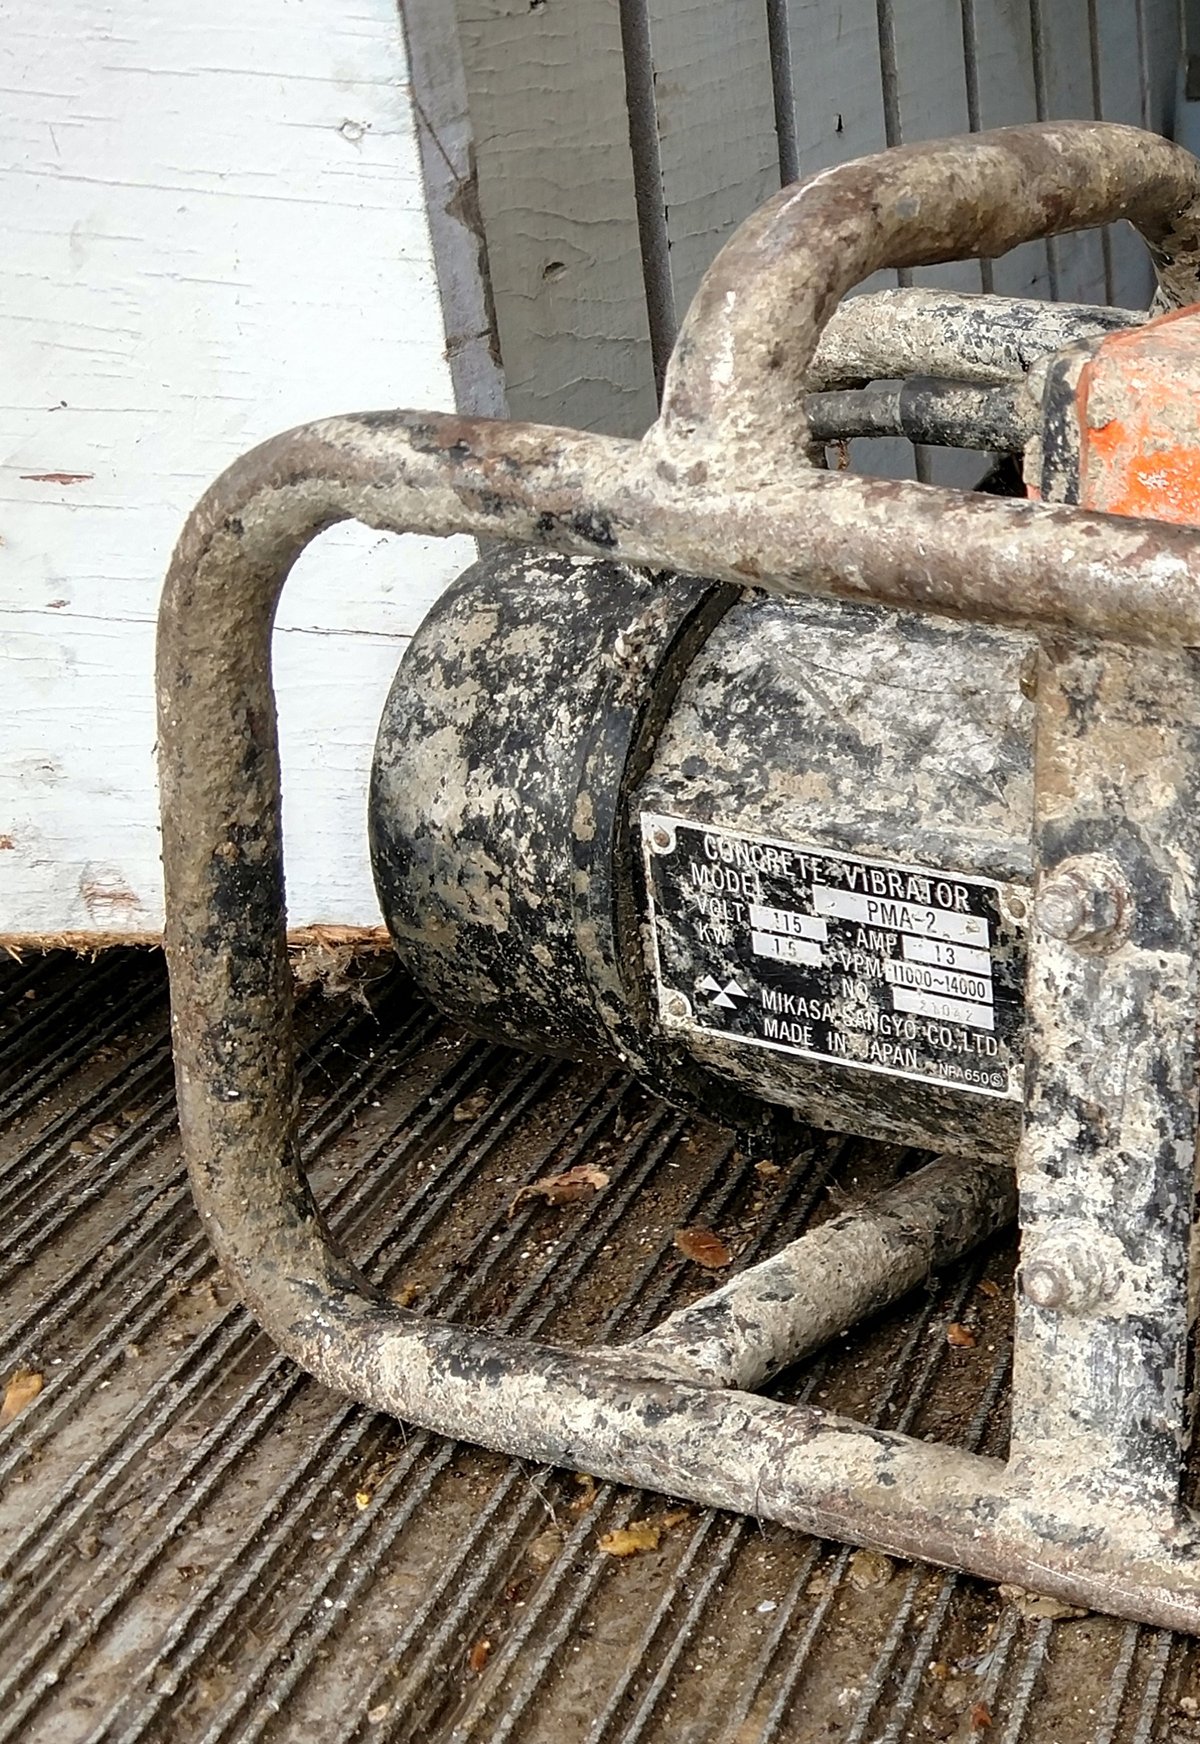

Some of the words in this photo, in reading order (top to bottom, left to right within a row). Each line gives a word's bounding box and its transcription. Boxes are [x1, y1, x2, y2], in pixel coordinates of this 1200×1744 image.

[690, 862, 768, 899] MODEL
[867, 900, 937, 933] PMA-2
[704, 834, 826, 883] CONCRETE
[843, 864, 971, 912] VIBRATOR
[696, 895, 744, 922] VOLT
[856, 929, 898, 954] AMP
[935, 945, 955, 965] 13
[839, 951, 882, 978] VPM
[762, 989, 834, 1023] MIKASA
[842, 1004, 917, 1040] SANGYO
[764, 1018, 814, 1046] MADE
[828, 1031, 846, 1053] IN
[862, 1039, 917, 1068] JAPAN
